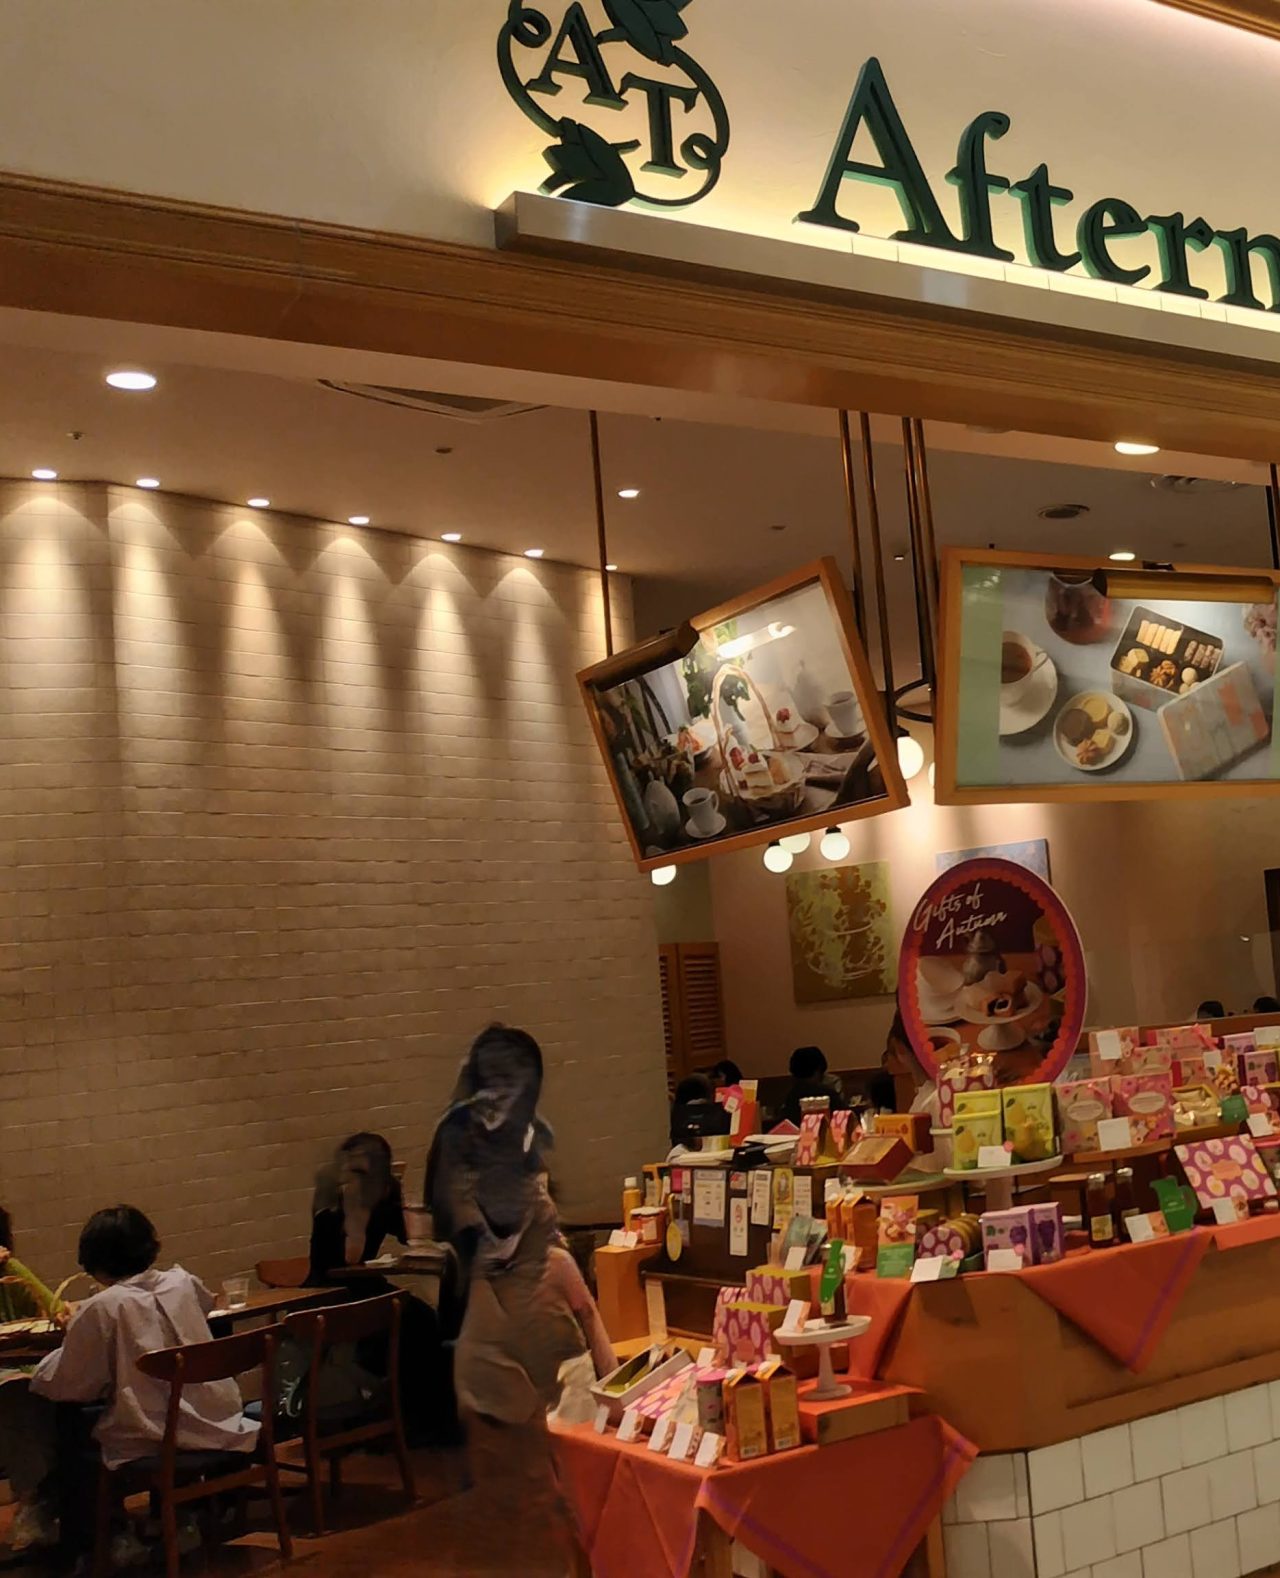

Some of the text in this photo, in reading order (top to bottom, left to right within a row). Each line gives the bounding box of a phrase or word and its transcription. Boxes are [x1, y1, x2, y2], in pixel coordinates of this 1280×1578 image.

[913, 882, 984, 932] Gifts of
[936, 911, 1008, 949] Autumn
